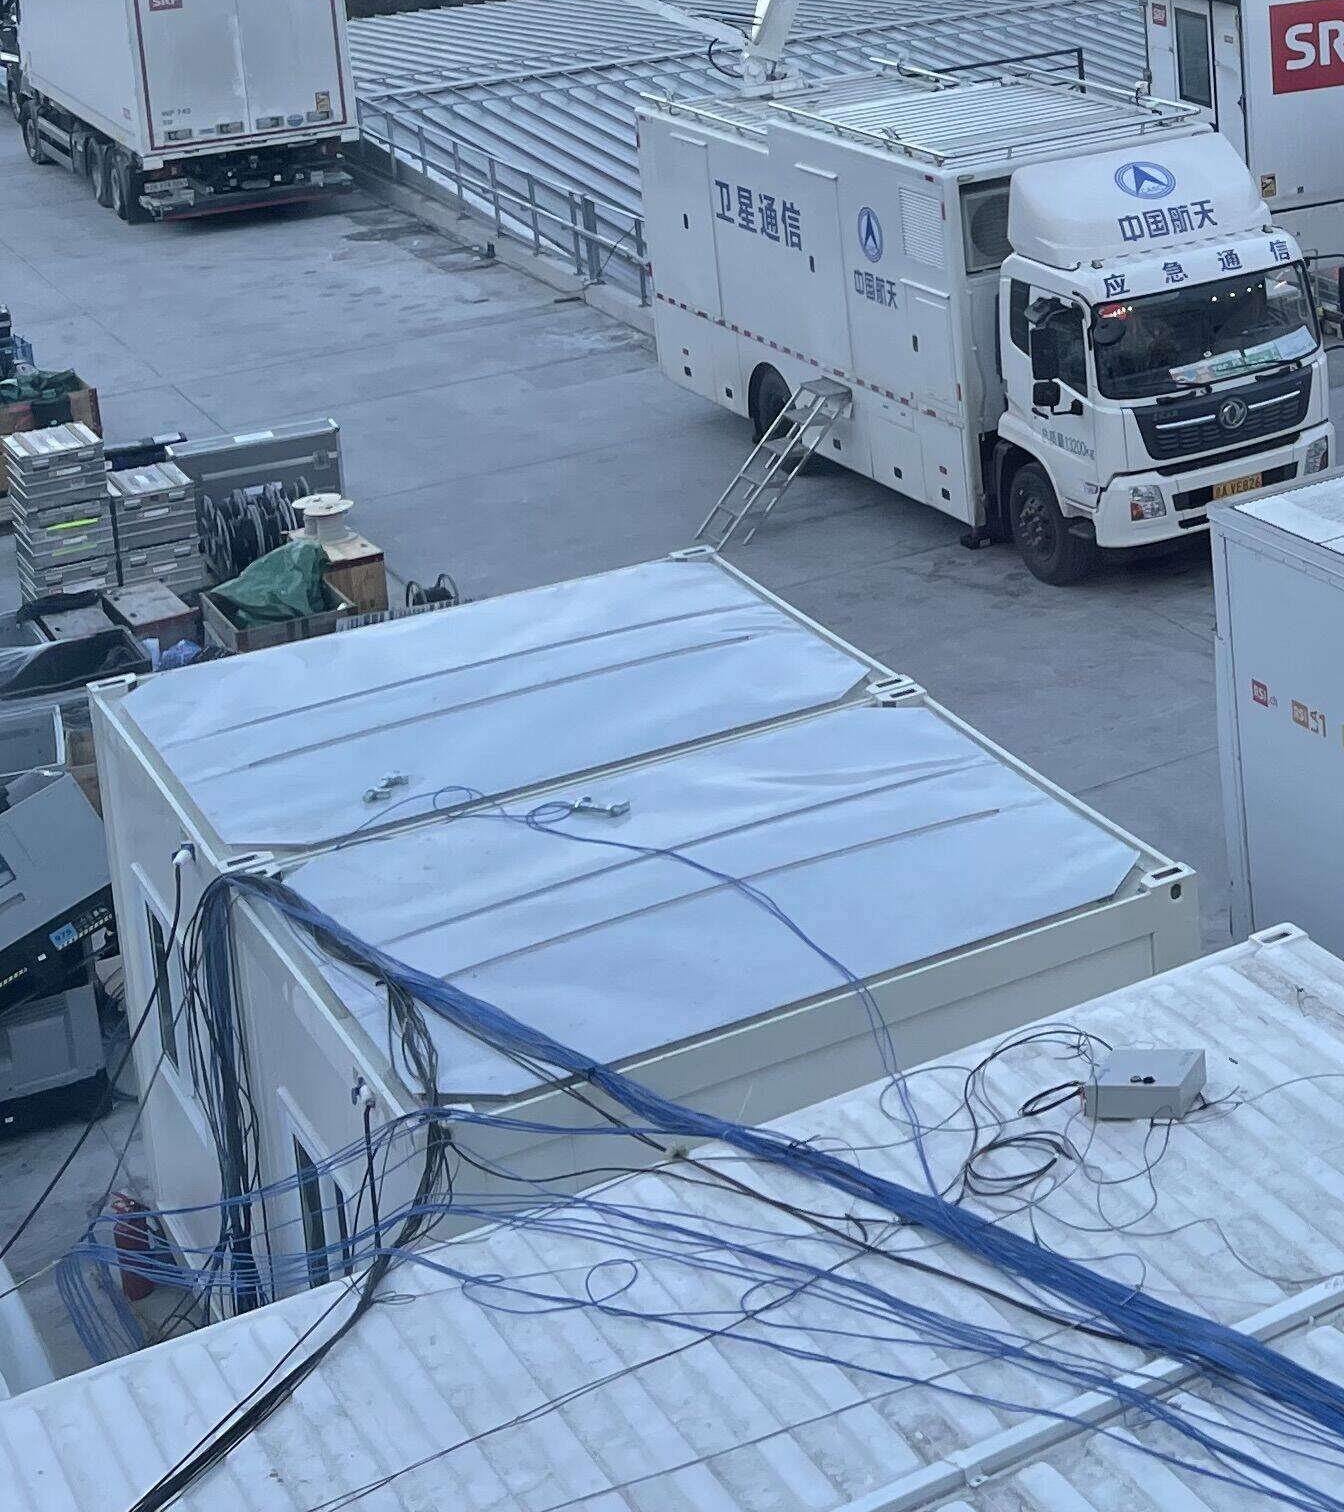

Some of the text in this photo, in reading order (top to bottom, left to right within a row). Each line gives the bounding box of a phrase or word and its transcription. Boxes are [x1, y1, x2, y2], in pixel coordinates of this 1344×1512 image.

[714, 179, 803, 251] 卫星通信
[1117, 199, 1218, 242] 中国航天
[853, 269, 899, 310] 中国航天
[1103, 240, 1291, 298] 应急通信
